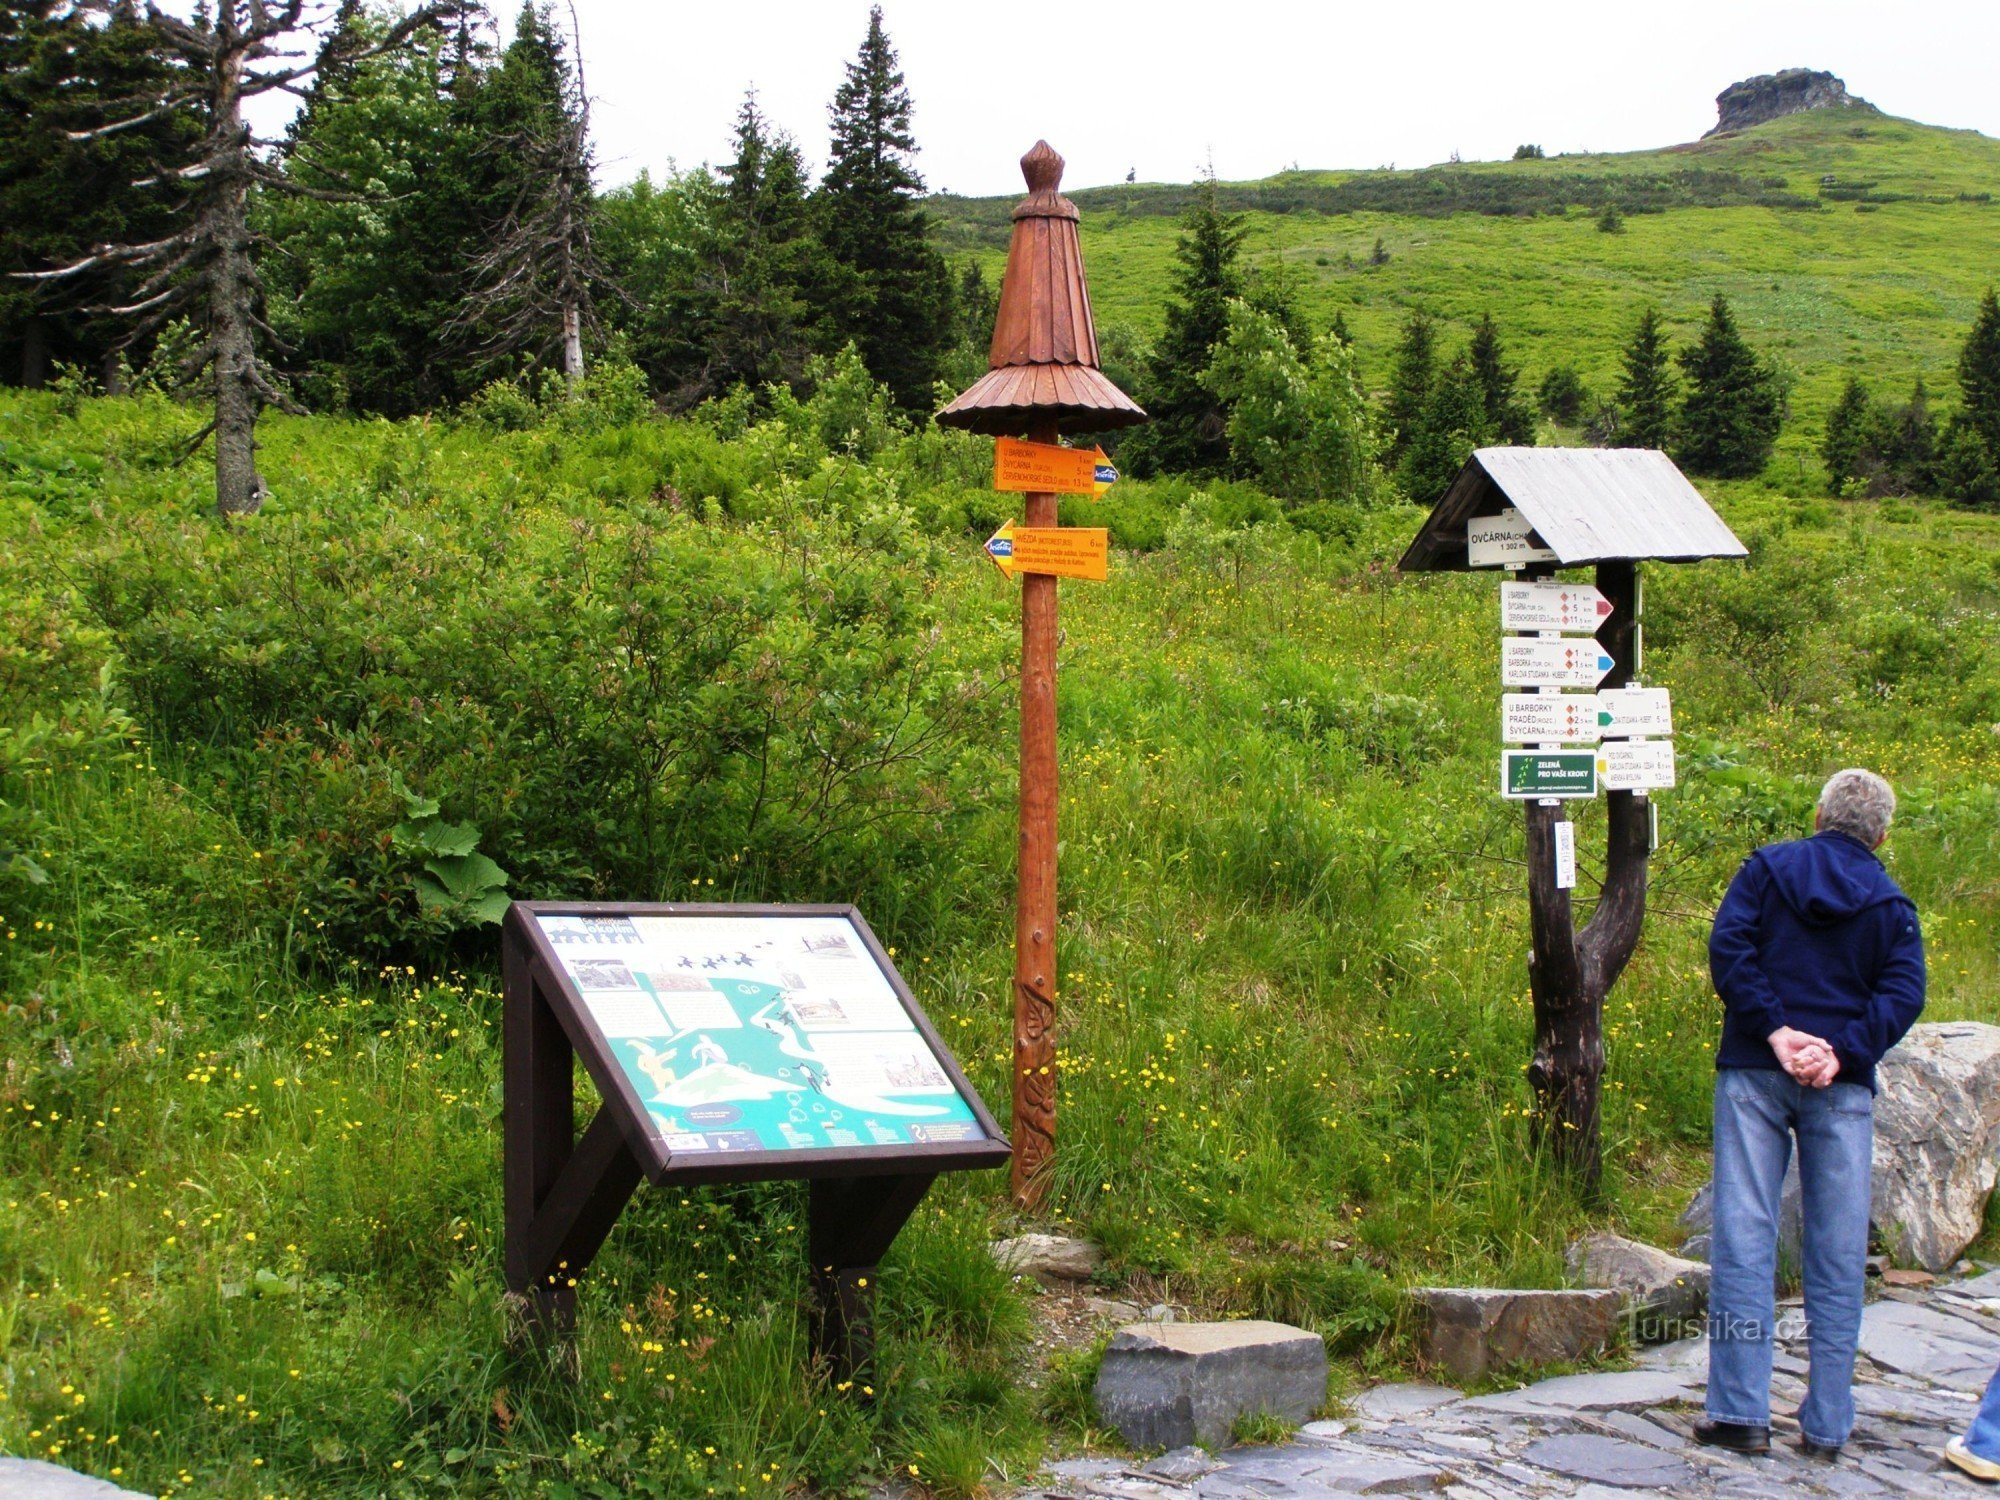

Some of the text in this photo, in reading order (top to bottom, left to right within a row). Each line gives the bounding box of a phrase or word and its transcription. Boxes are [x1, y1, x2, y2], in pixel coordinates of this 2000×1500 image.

[1471, 531, 1513, 544] OVČÁRNA
[1515, 704, 1552, 712] BARBORKY
[1537, 760, 1561, 769] ZELENÁ
[1551, 769, 1567, 777] VAŠE
